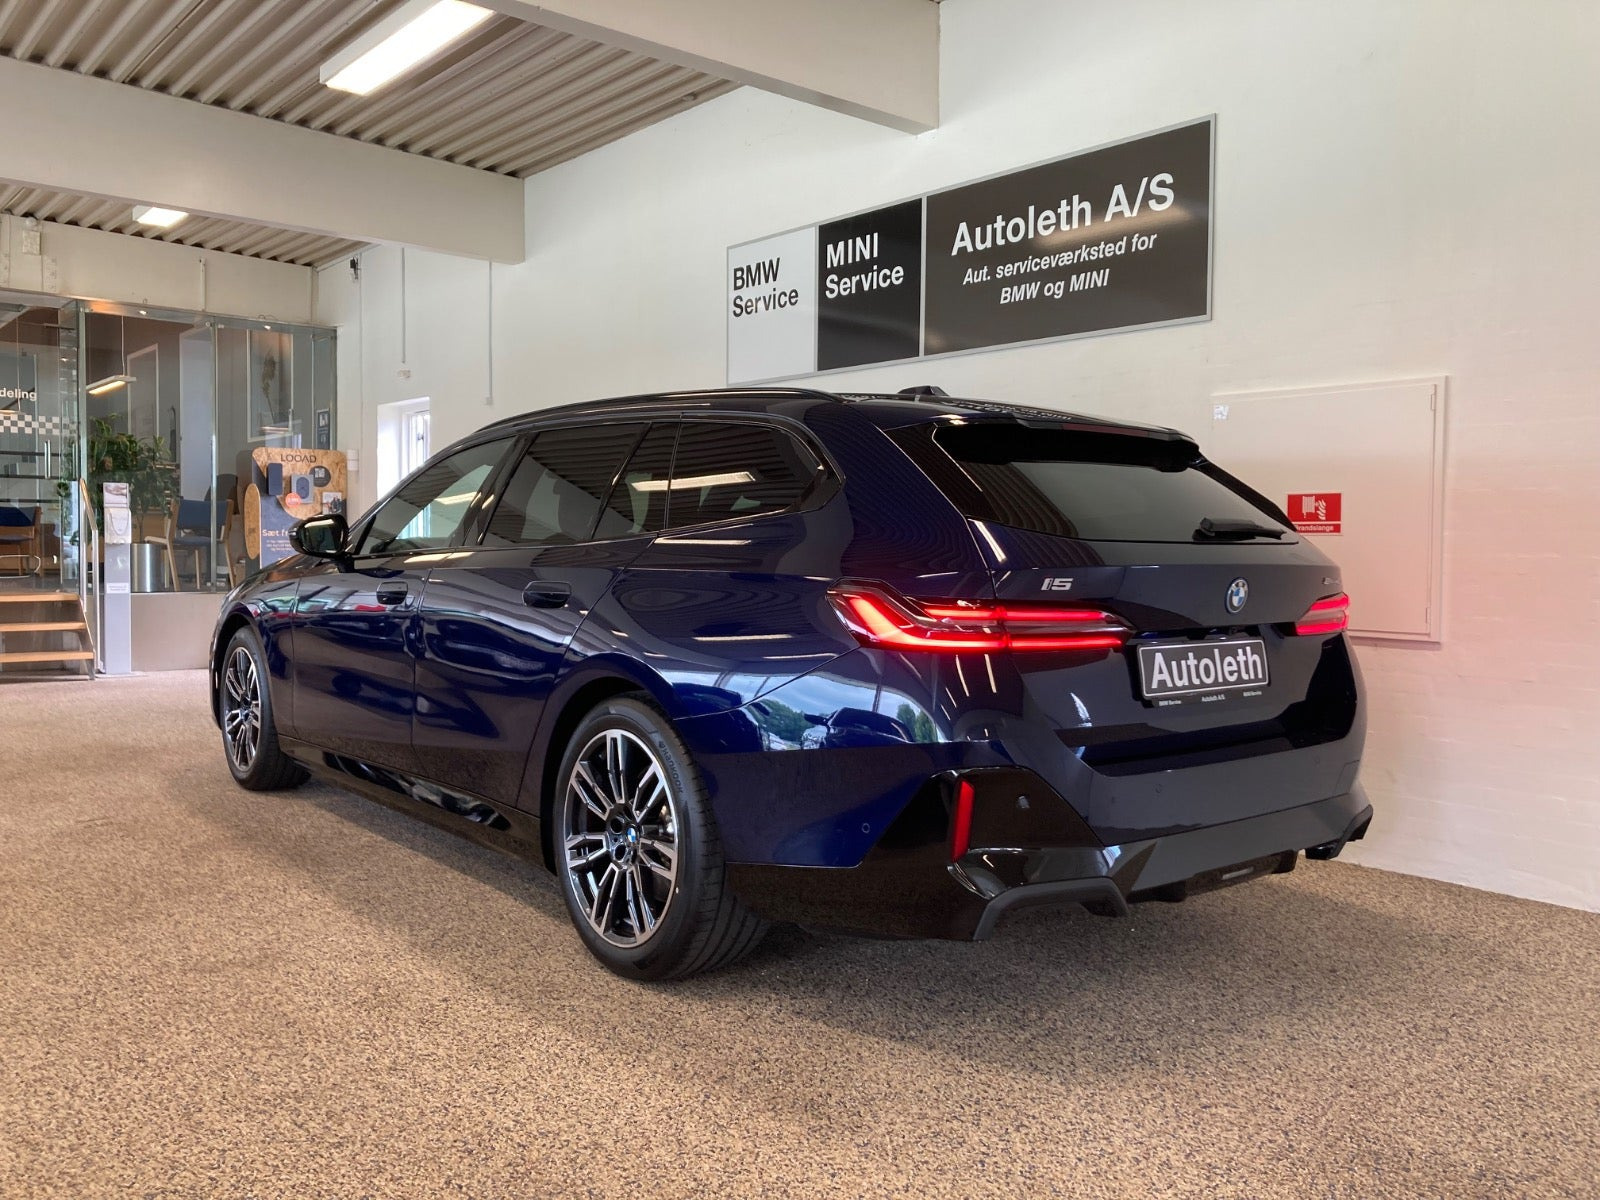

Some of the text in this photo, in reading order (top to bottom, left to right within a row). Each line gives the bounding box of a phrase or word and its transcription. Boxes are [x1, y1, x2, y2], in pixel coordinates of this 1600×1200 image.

[951, 172, 1175, 256] Autoleth A/S
[826, 232, 879, 269] MINI
[963, 232, 1158, 285] Aut. serviceværksted for
[733, 257, 780, 291] BMW
[825, 264, 905, 299] Service
[1000, 268, 1110, 304] BMW og MINI
[732, 287, 799, 318] Service
[1151, 646, 1263, 689] Autoleth
